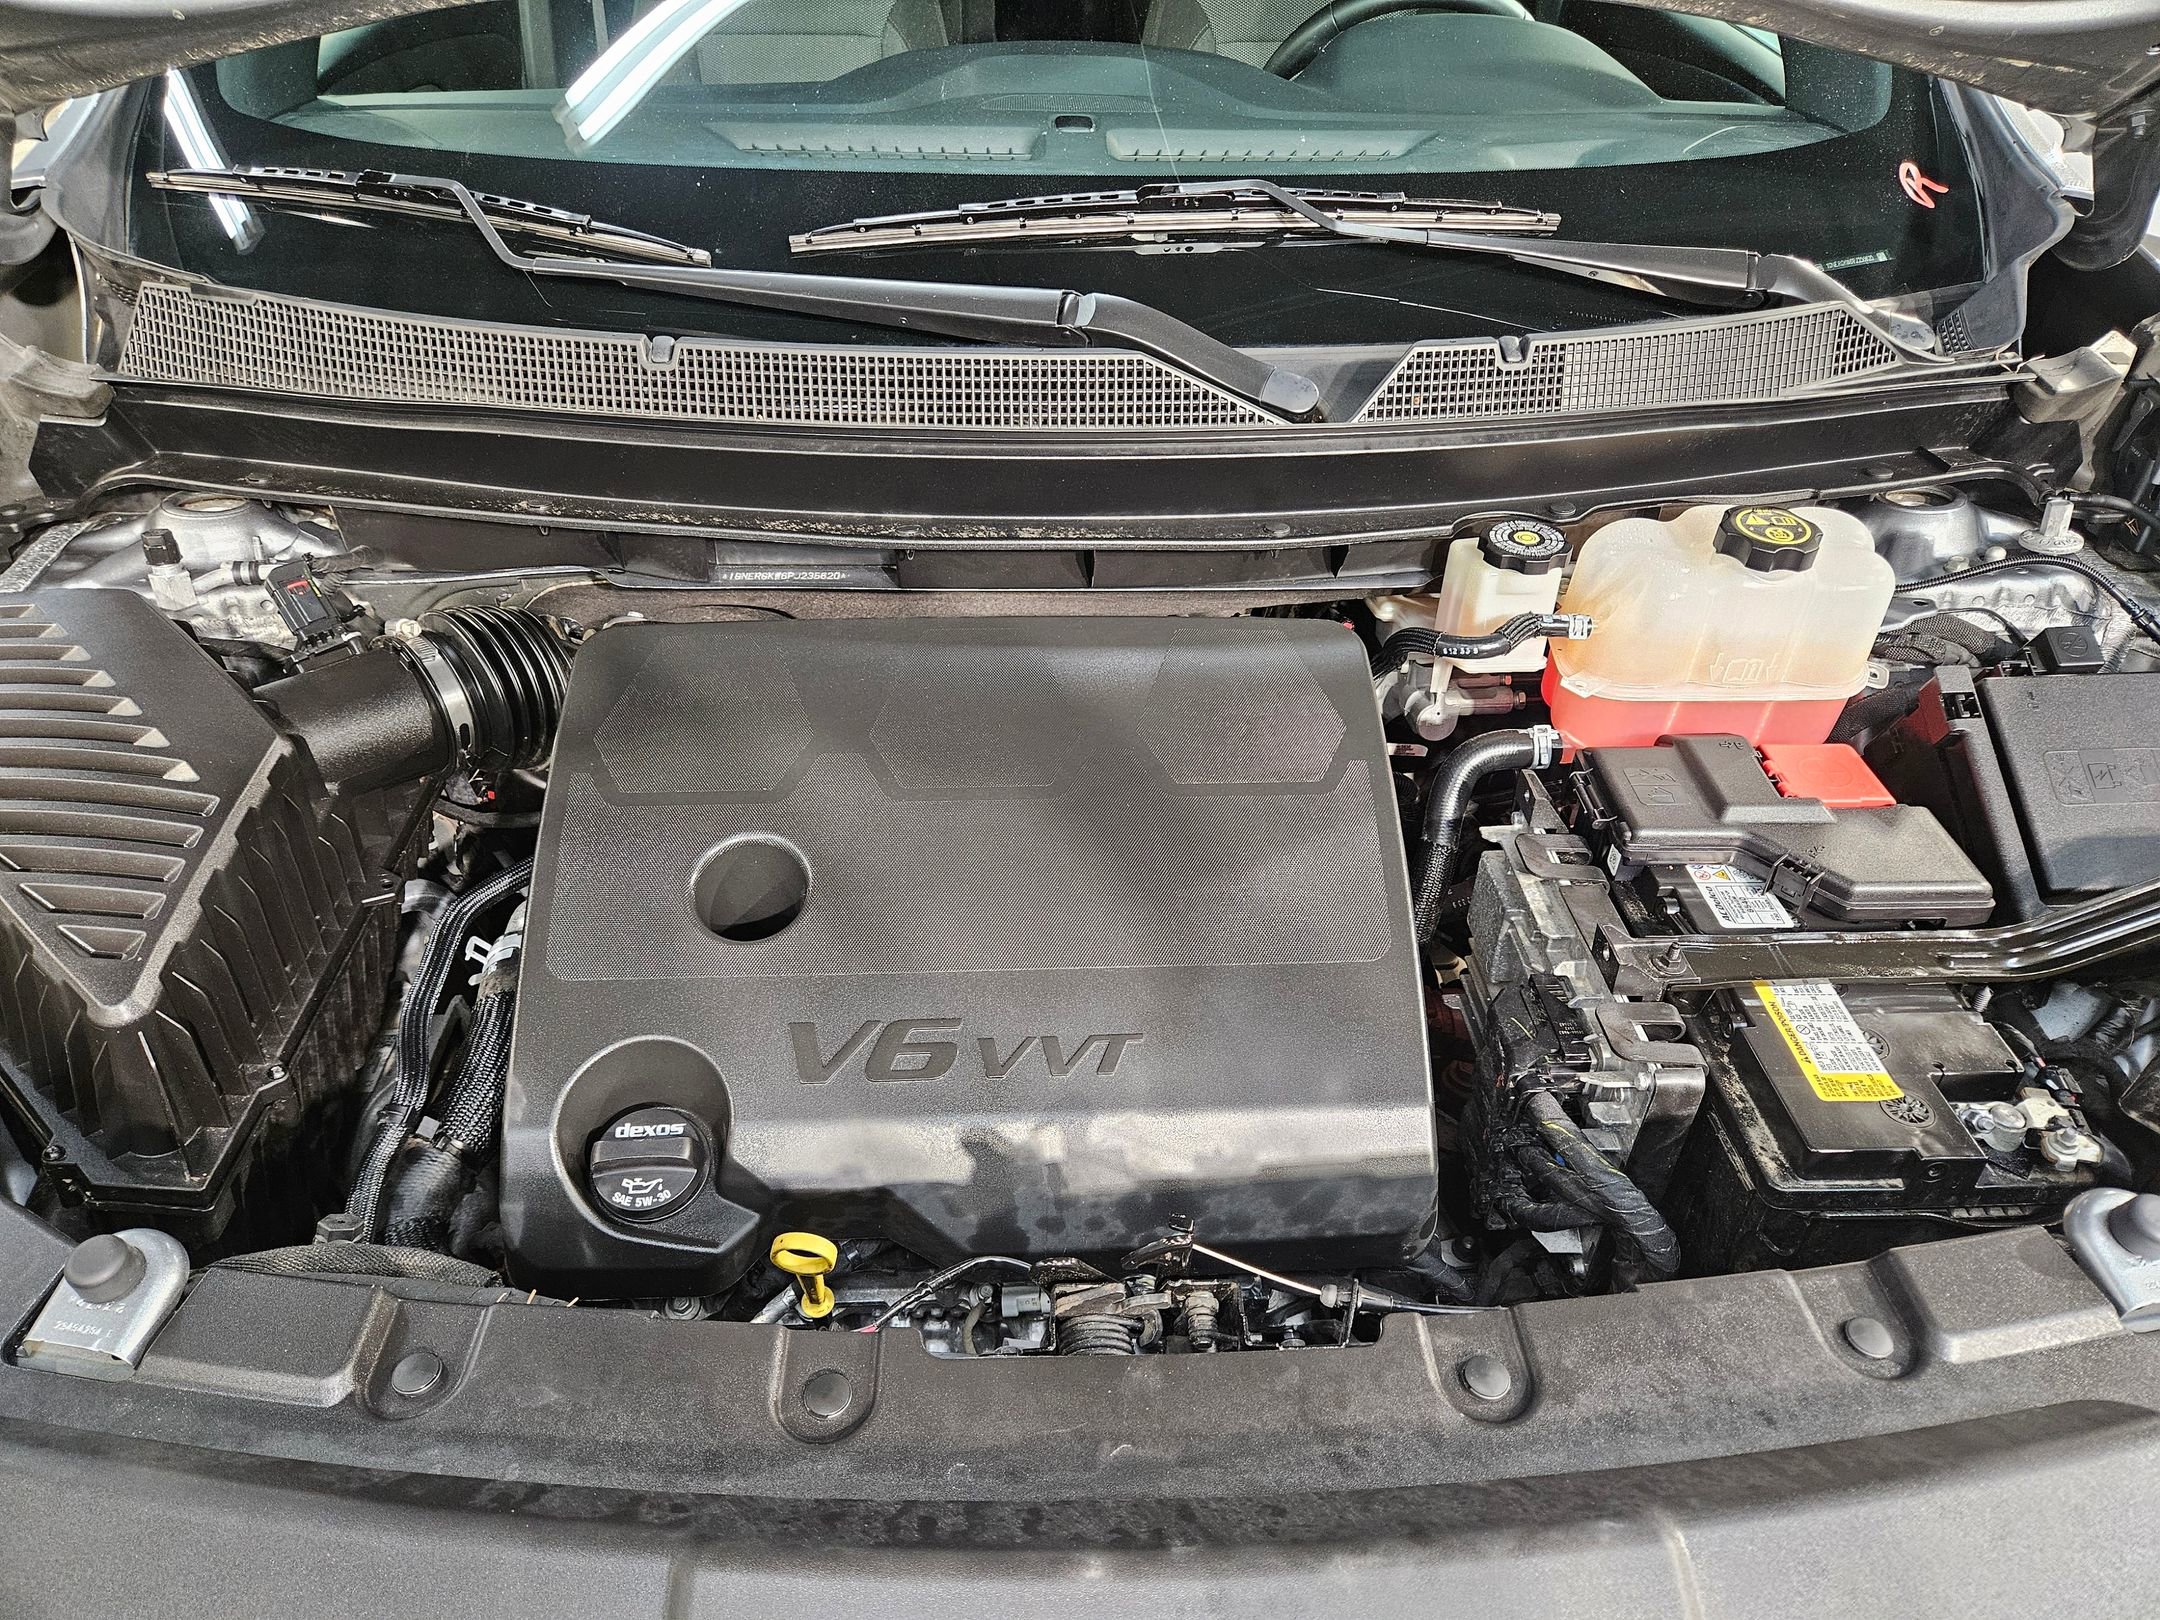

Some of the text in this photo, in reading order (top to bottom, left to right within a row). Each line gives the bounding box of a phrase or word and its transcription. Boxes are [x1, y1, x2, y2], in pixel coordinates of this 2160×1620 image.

[1899, 162, 1949, 208] R
[788, 1018, 1143, 1085] V6 VVT
[614, 1123, 687, 1139] dexos
[612, 1189, 672, 1208] SAE 5W-30
